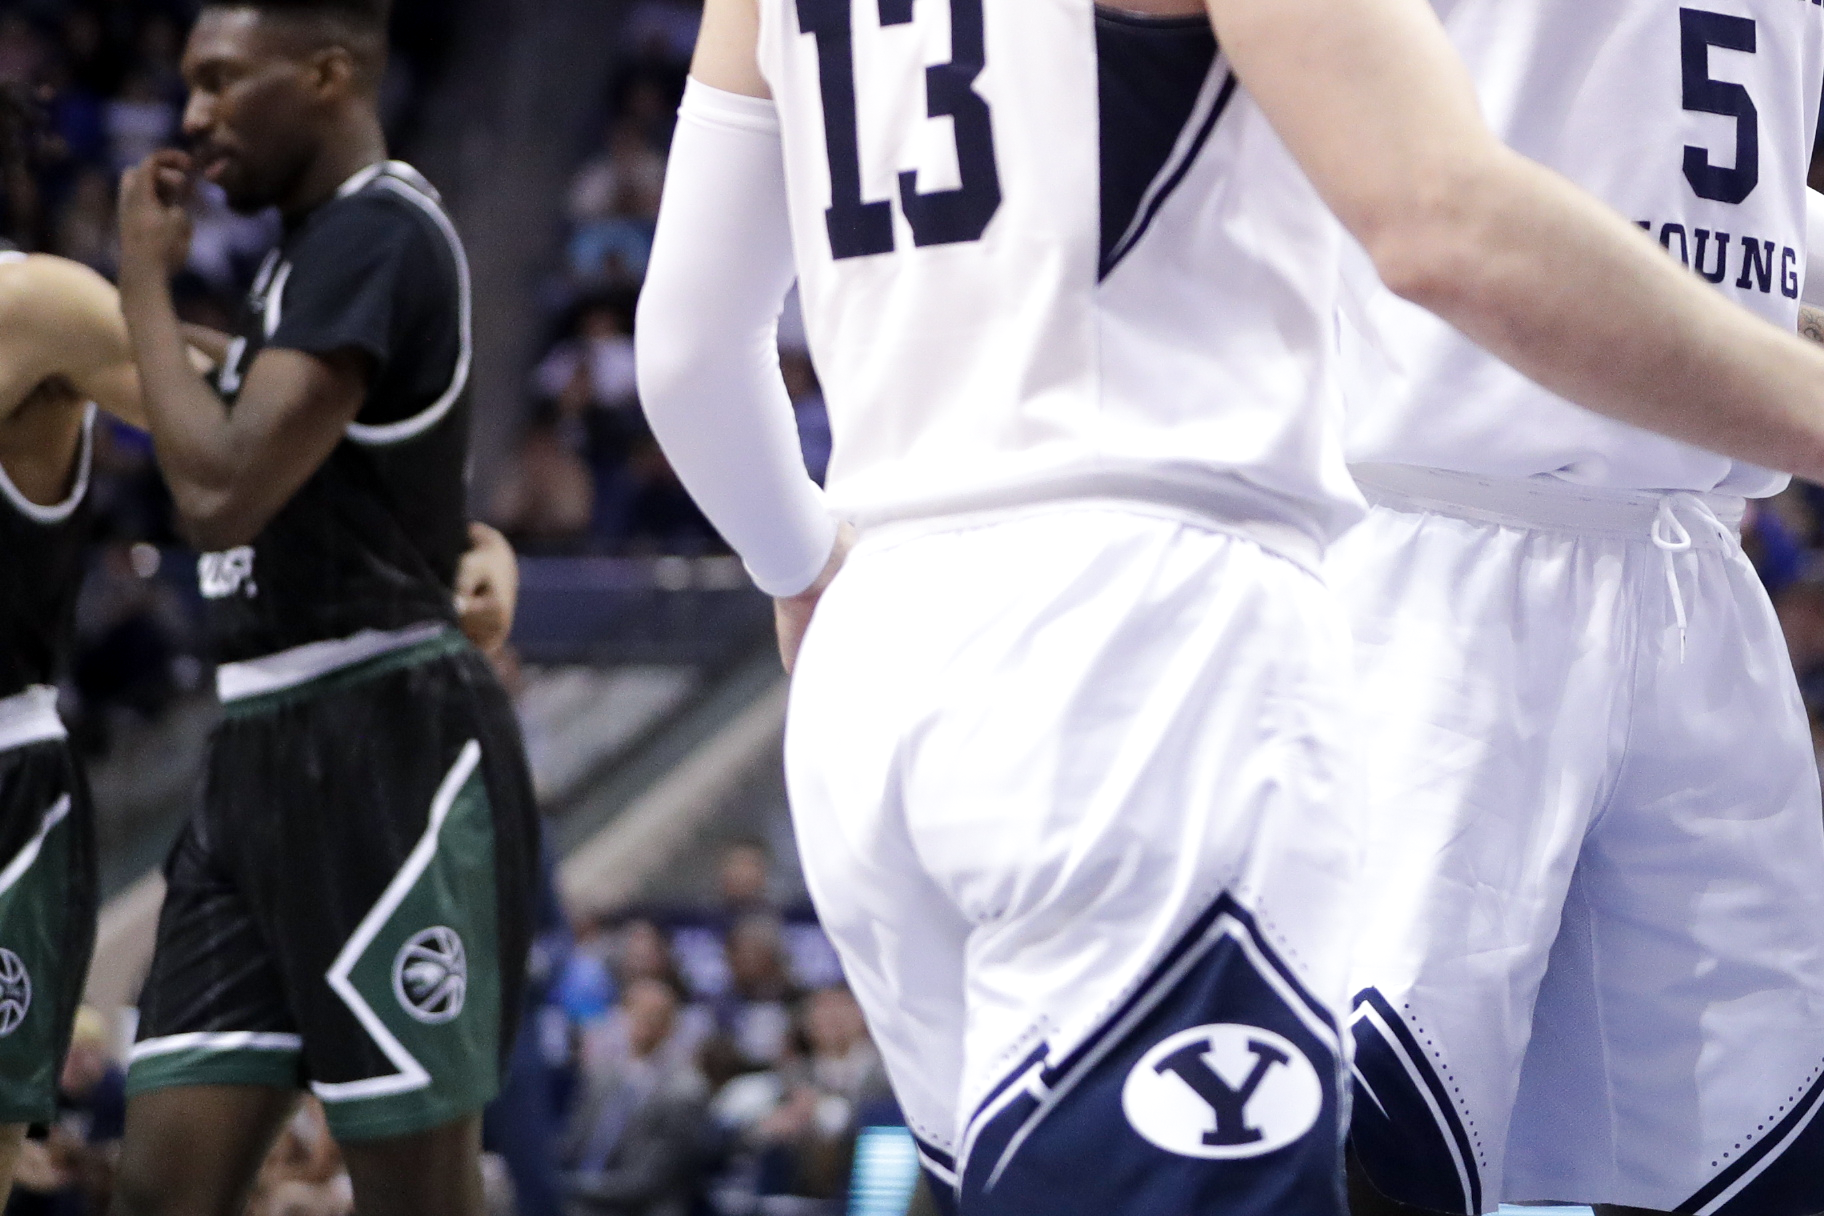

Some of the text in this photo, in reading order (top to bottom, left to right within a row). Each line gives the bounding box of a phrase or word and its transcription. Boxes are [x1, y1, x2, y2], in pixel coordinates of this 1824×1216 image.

[1679, 6, 1759, 206] 5
[1632, 220, 1798, 299] OUNG
[1153, 1038, 1290, 1146] Y
